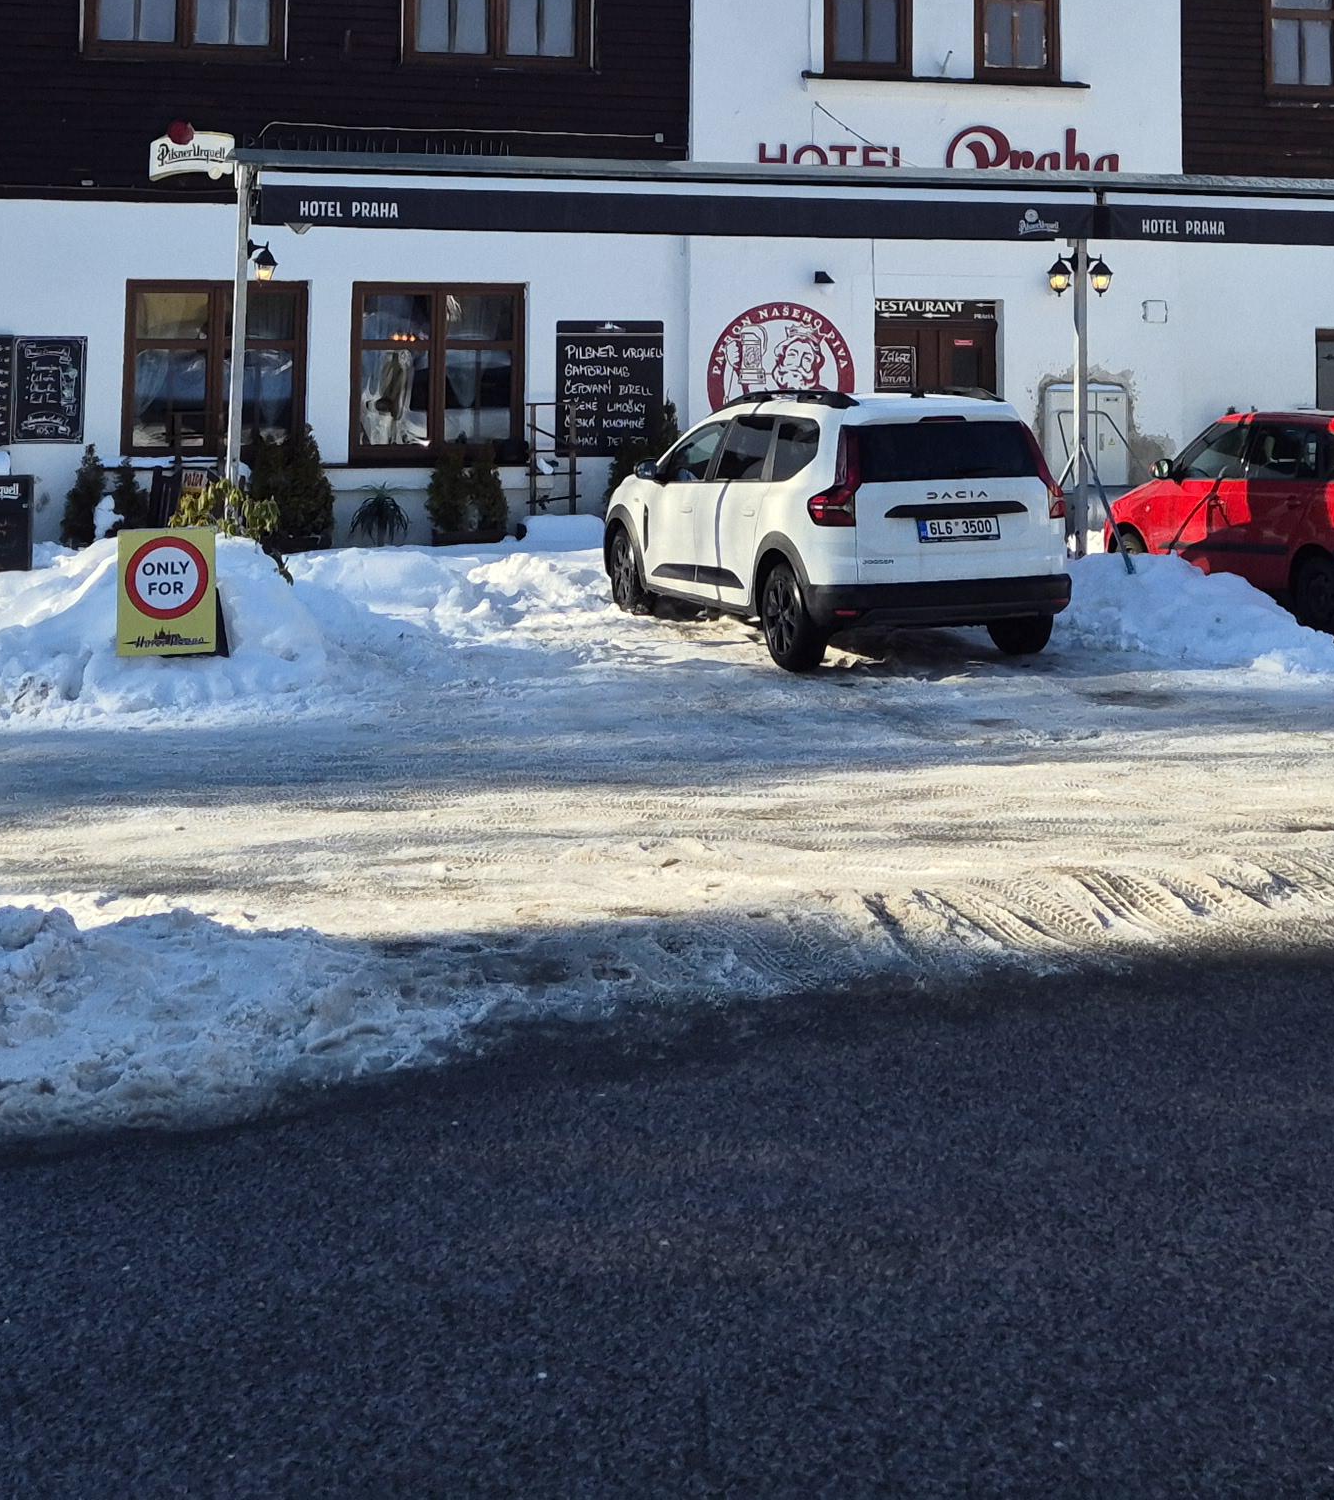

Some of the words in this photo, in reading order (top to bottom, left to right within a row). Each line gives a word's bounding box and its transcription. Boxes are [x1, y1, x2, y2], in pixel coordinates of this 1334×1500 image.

[299, 201, 343, 218] HOTEL
[351, 201, 399, 219] PRAHA
[1142, 219, 1179, 235] HOTEL
[1185, 220, 1225, 236] PRAHA
[758, 305, 823, 330] NAŠEHO
[826, 329, 849, 369] PIVA
[927, 490, 988, 500] DACIA
[929, 521, 953, 535] 6L6
[962, 519, 992, 534] 3500
[142, 561, 190, 576] ONLY
[147, 581, 184, 596] FOR
